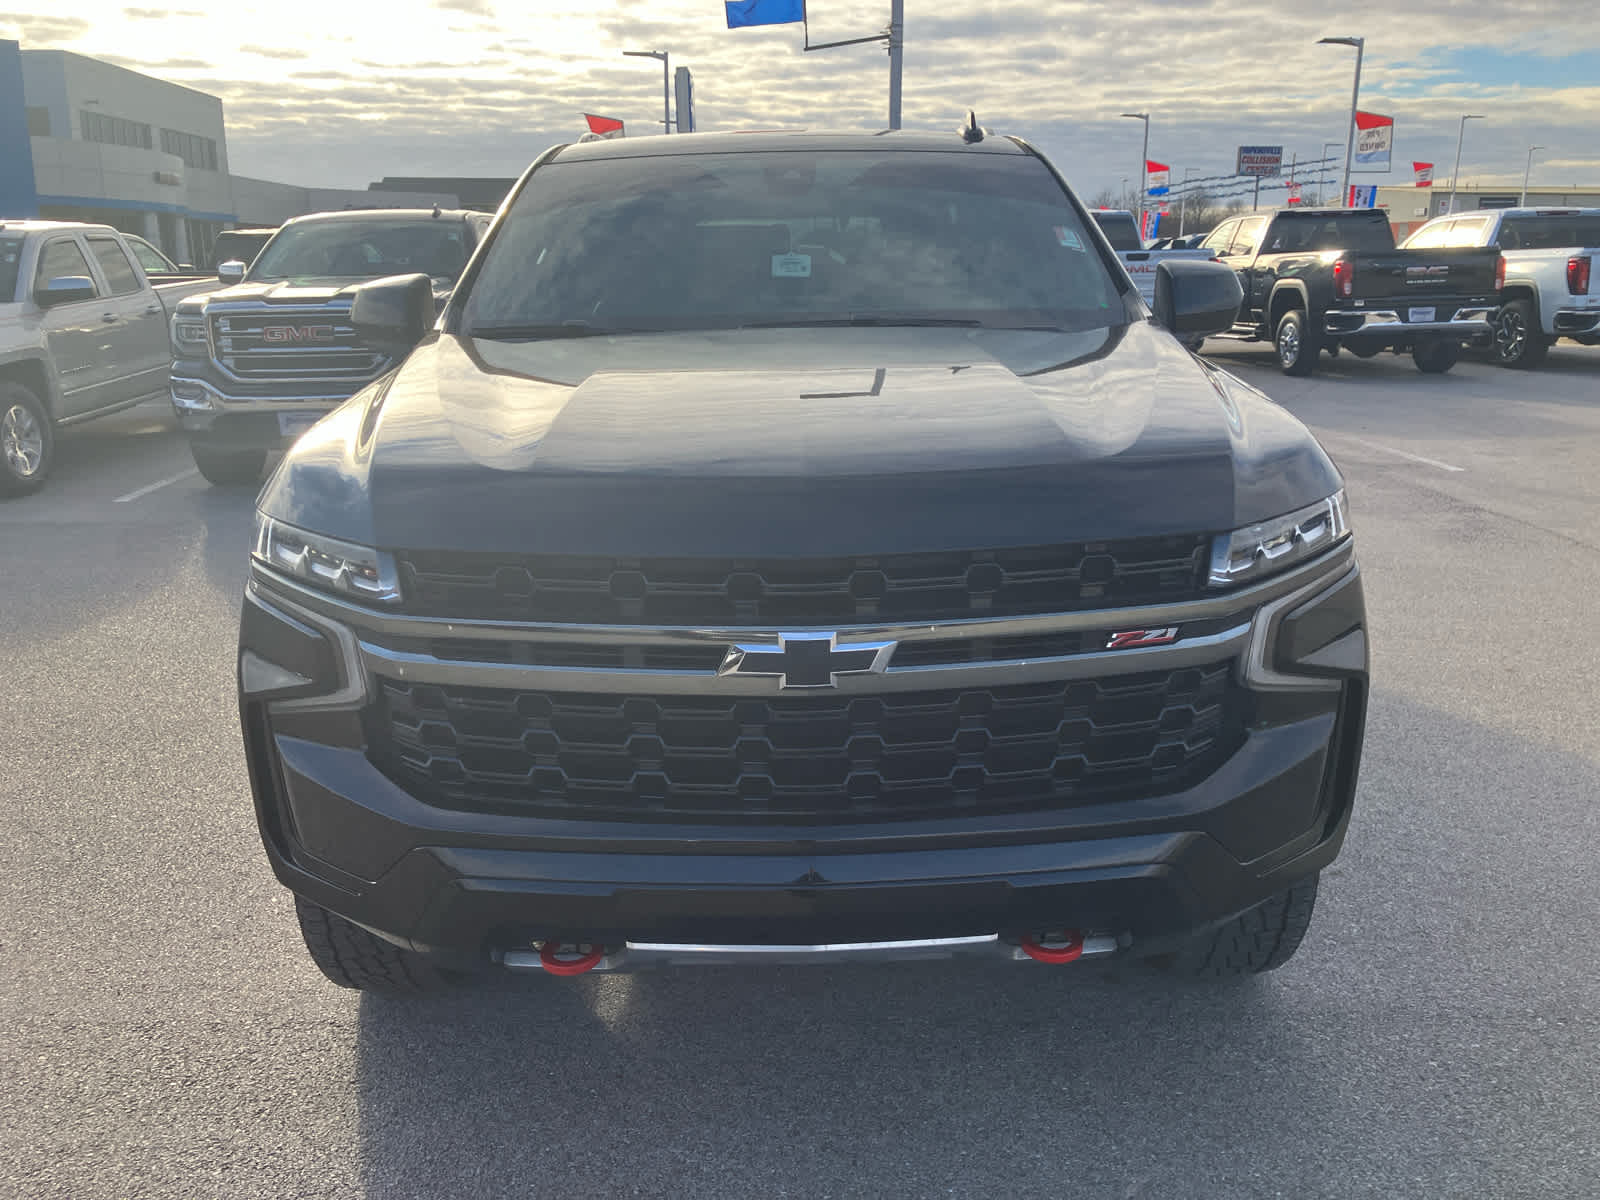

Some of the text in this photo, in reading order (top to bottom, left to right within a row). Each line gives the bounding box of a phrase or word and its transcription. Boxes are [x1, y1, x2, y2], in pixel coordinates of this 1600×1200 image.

[1241, 156, 1281, 164] COLLISION
[263, 325, 335, 342] GMC
[1105, 627, 1178, 648] Z71
